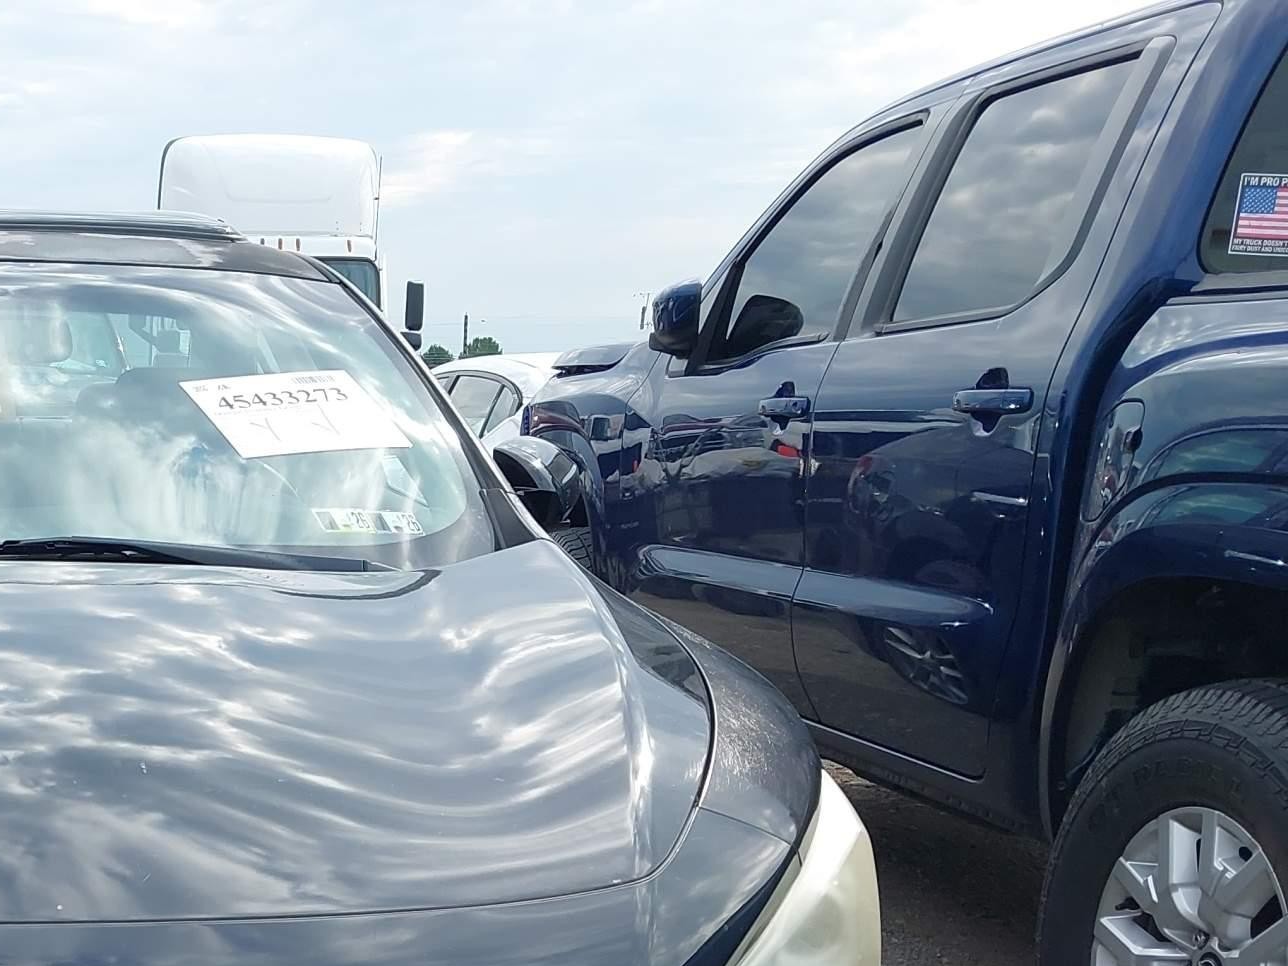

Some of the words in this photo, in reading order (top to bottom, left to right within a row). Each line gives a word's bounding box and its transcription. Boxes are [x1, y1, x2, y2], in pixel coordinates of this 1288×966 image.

[1244, 176, 1259, 186] I'M
[1260, 177, 1279, 187] PRO
[1243, 238, 1262, 246] TRUCK
[218, 387, 348, 409] 45433273
